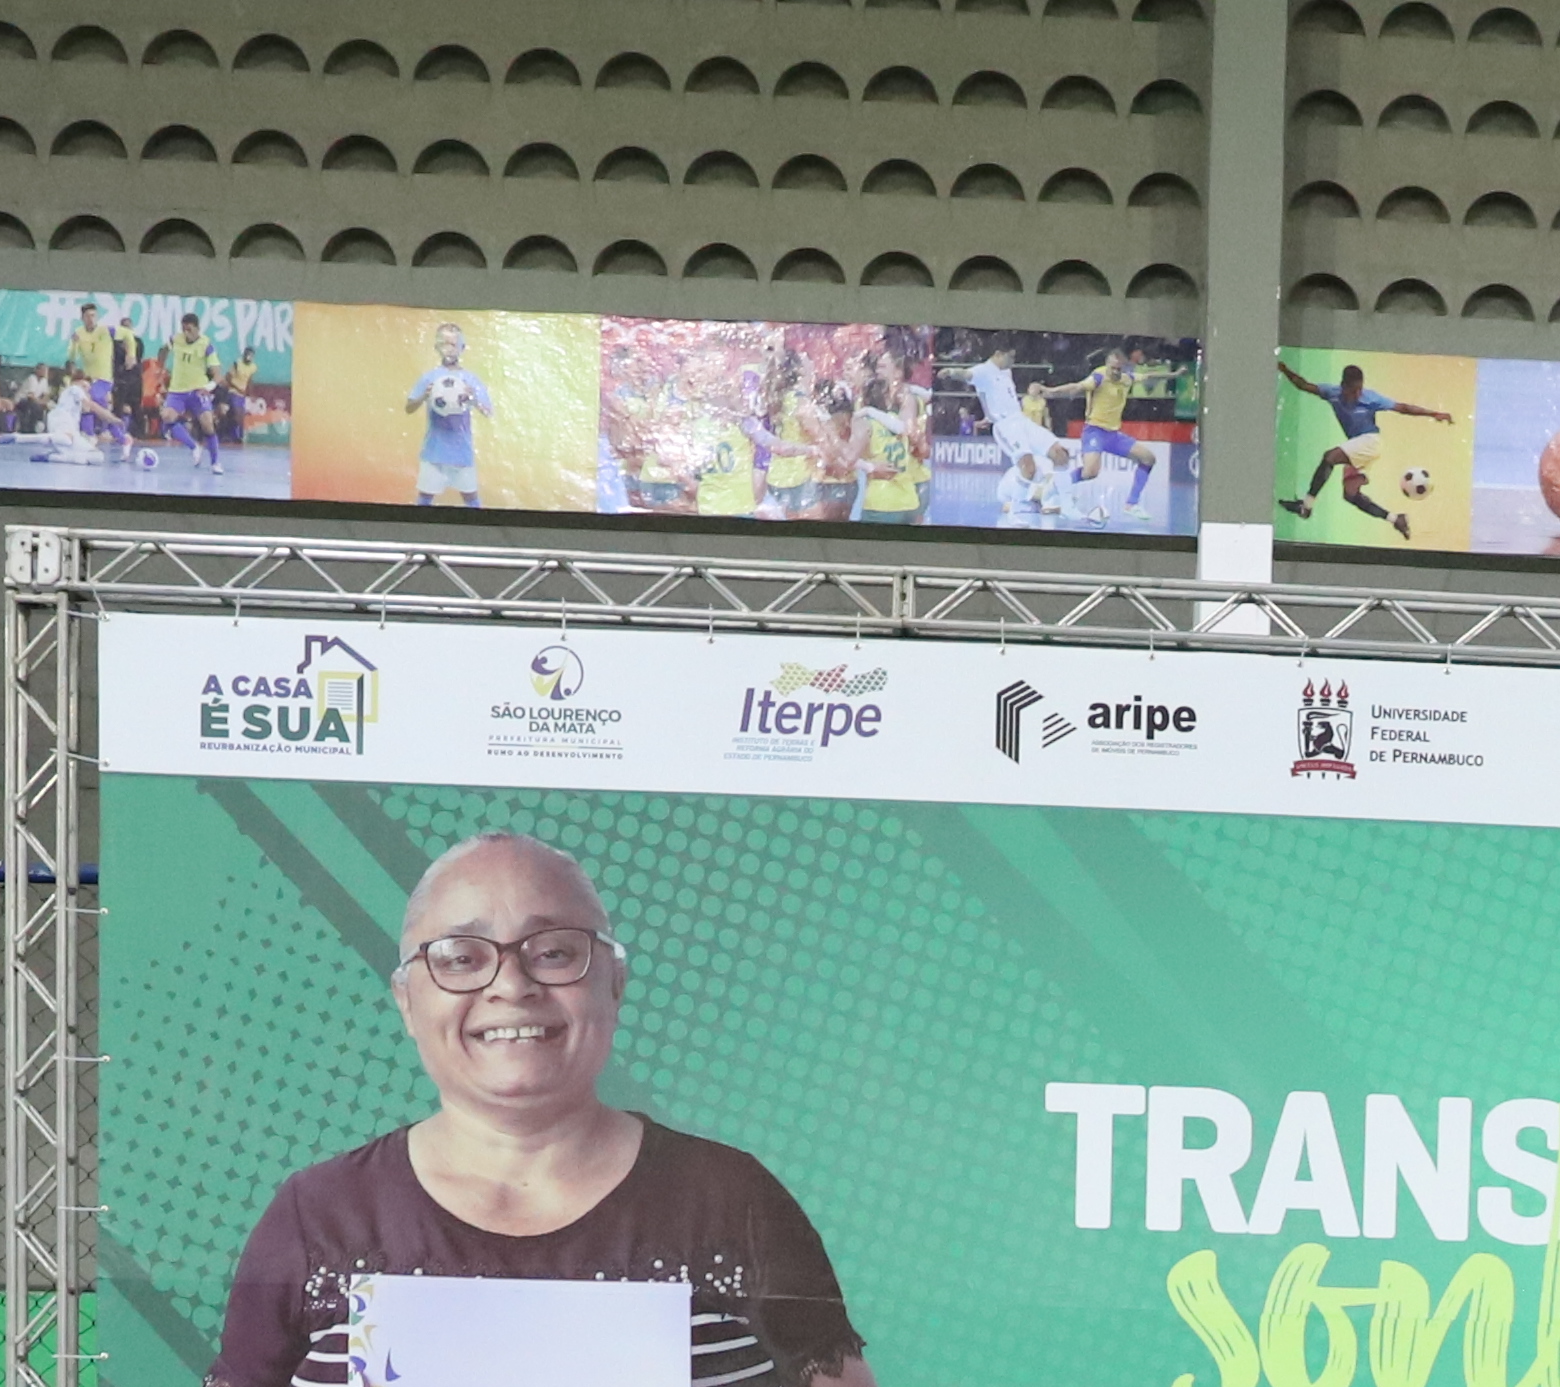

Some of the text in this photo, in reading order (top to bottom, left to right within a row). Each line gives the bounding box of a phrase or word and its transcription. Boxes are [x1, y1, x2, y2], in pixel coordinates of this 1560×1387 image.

[201, 674, 314, 700] A CASA
[200, 697, 352, 744] É SUA
[490, 701, 622, 726] SÃO LOURENÇO
[739, 687, 882, 748] Iterpe
[1087, 694, 1198, 741] aripe
[488, 735, 622, 746] PREFEITURA MUNICIPAL
[528, 721, 596, 735] DA MATA
[199, 742, 352, 756] REURBANIZAÇÃO MUNICIPAL
